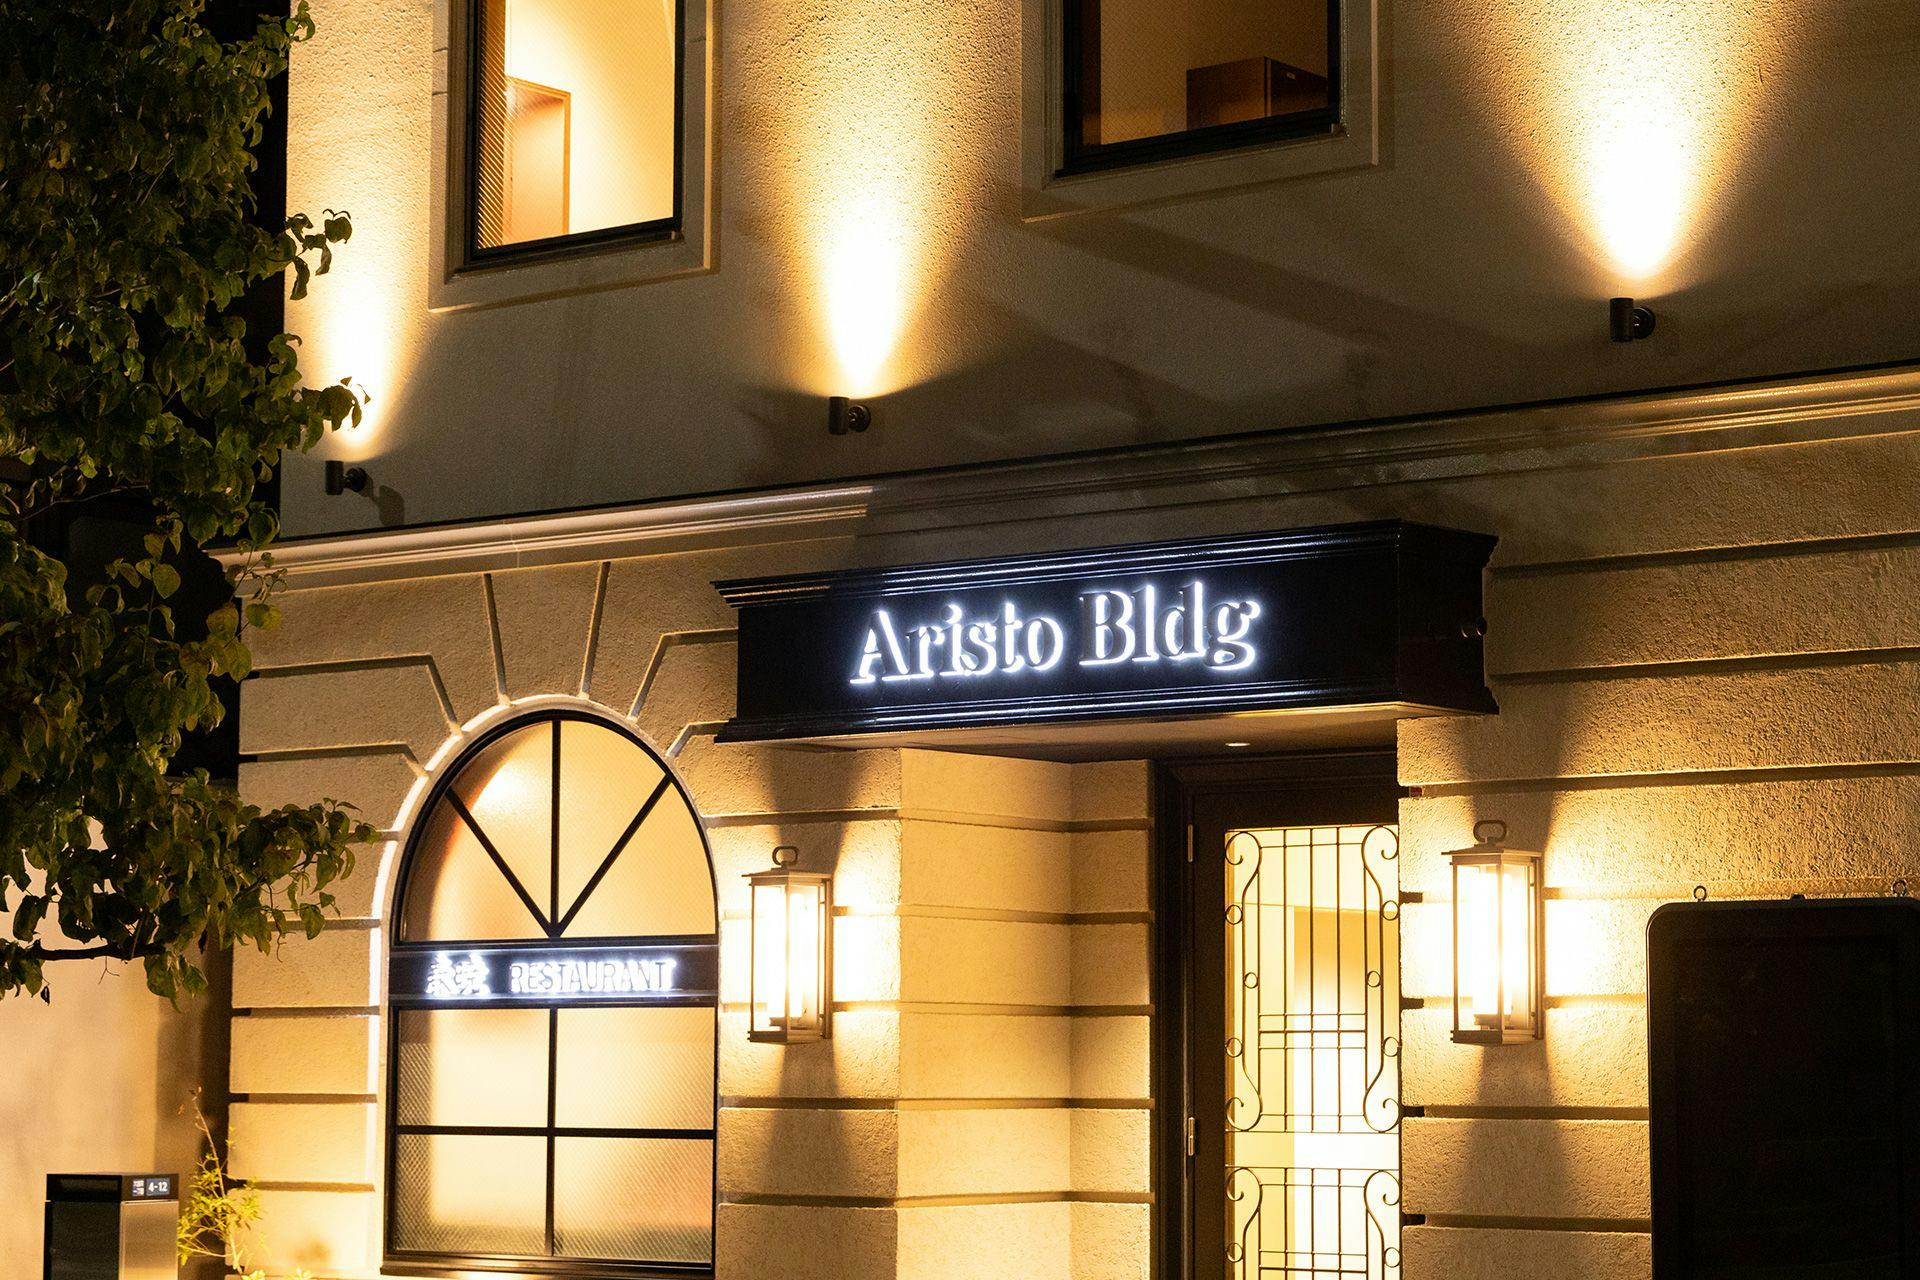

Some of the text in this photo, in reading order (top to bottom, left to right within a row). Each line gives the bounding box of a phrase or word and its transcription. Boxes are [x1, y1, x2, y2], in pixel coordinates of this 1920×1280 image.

[848, 579, 1262, 686] Aristo Bldg
[509, 958, 678, 993] RESTAURANT
[148, 1181, 168, 1192] 4-12
